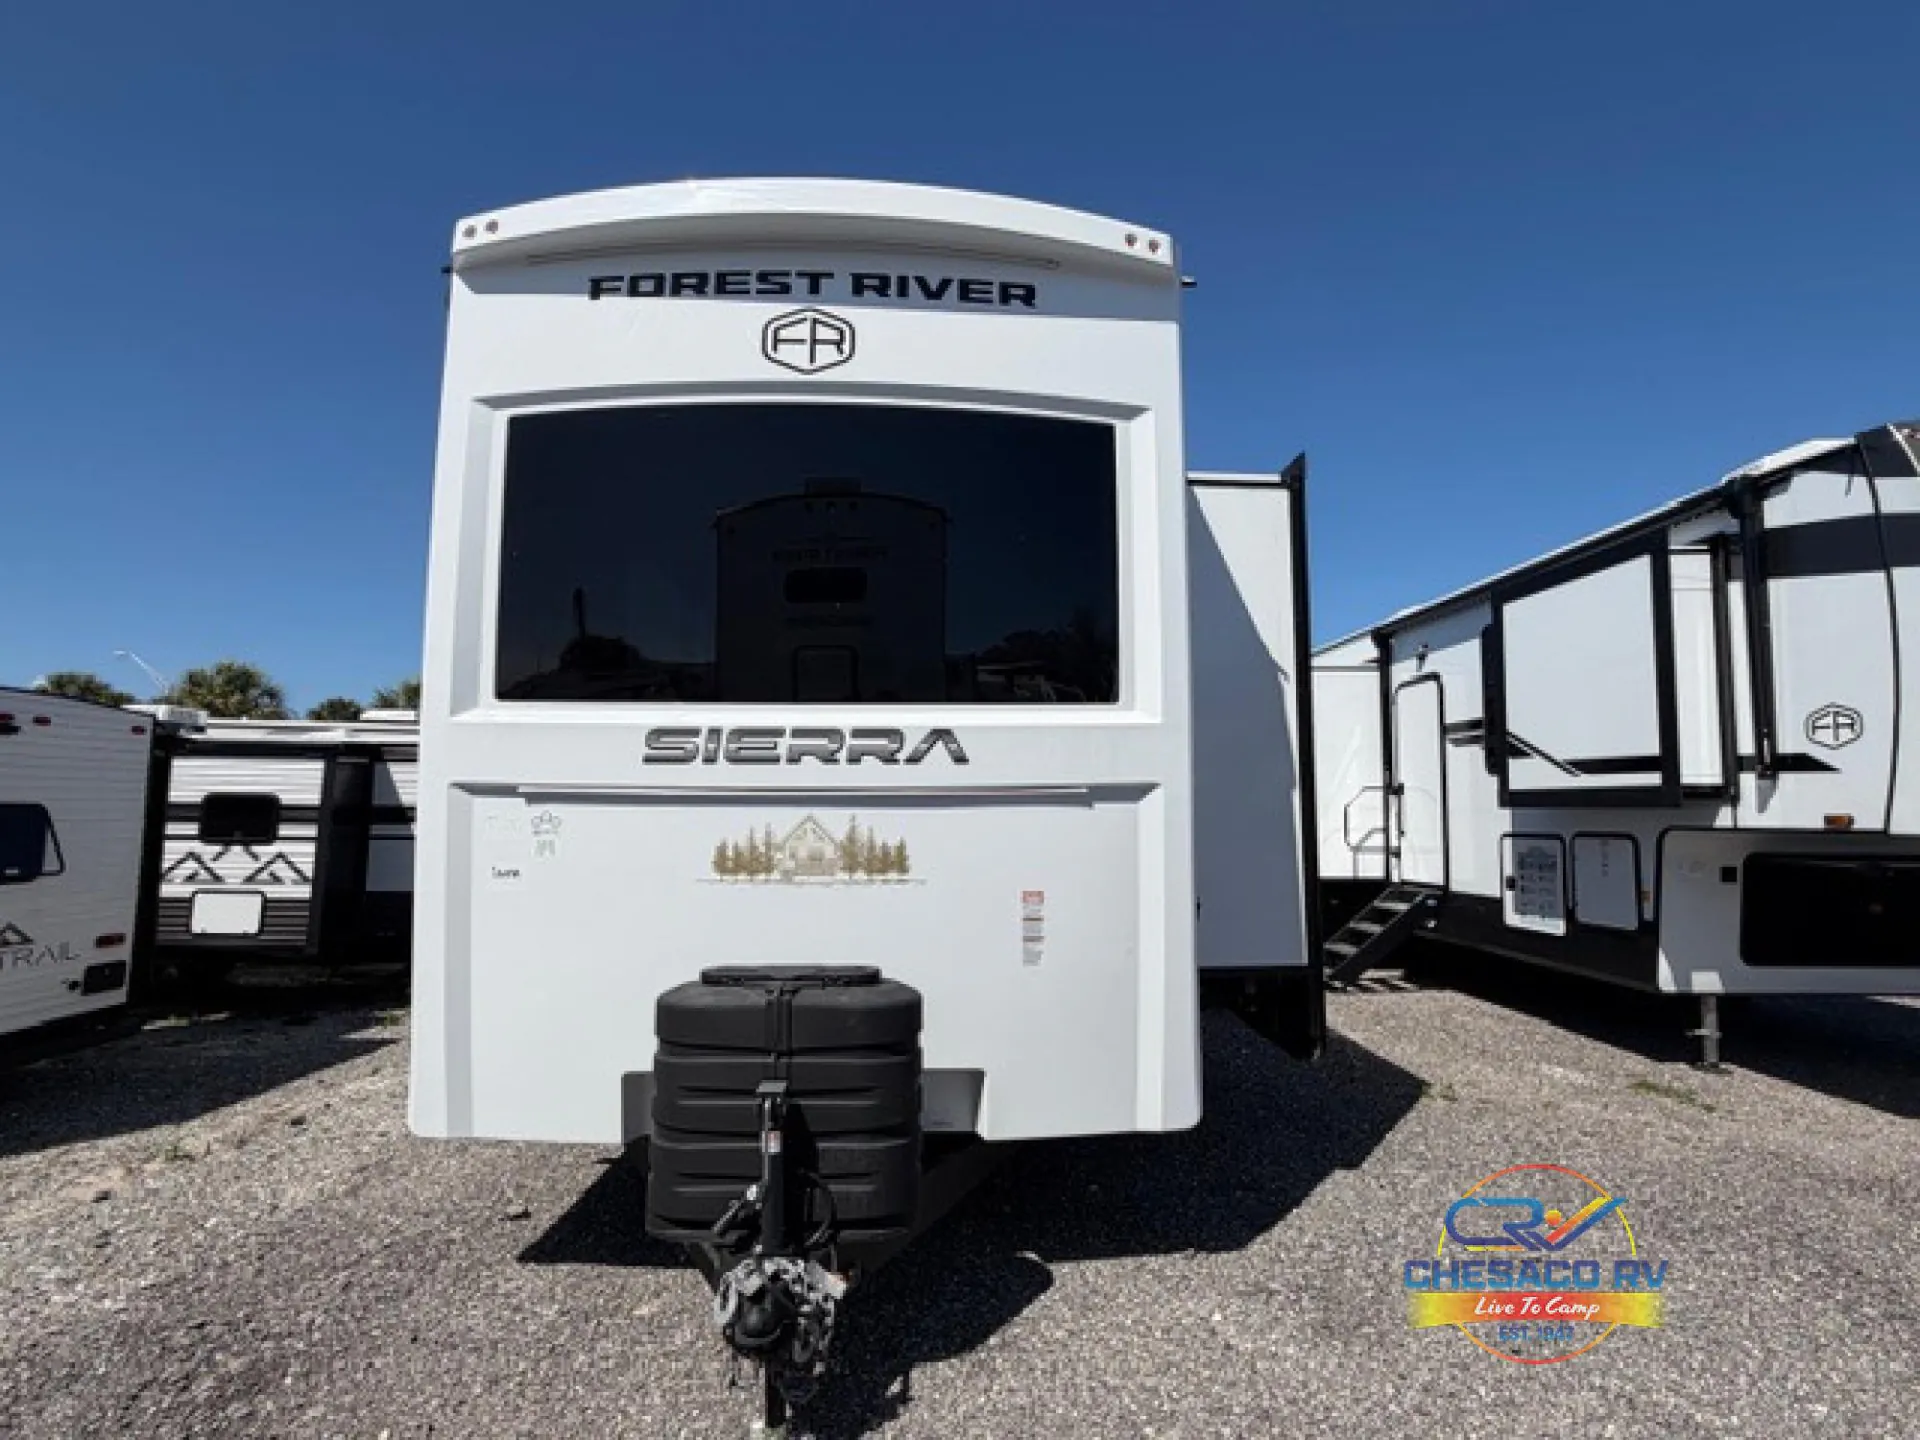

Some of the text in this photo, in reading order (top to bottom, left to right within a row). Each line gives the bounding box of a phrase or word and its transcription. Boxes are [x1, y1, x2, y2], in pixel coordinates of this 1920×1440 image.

[588, 270, 1036, 307] FOREST RIVER
[642, 727, 969, 766] SIERRA
